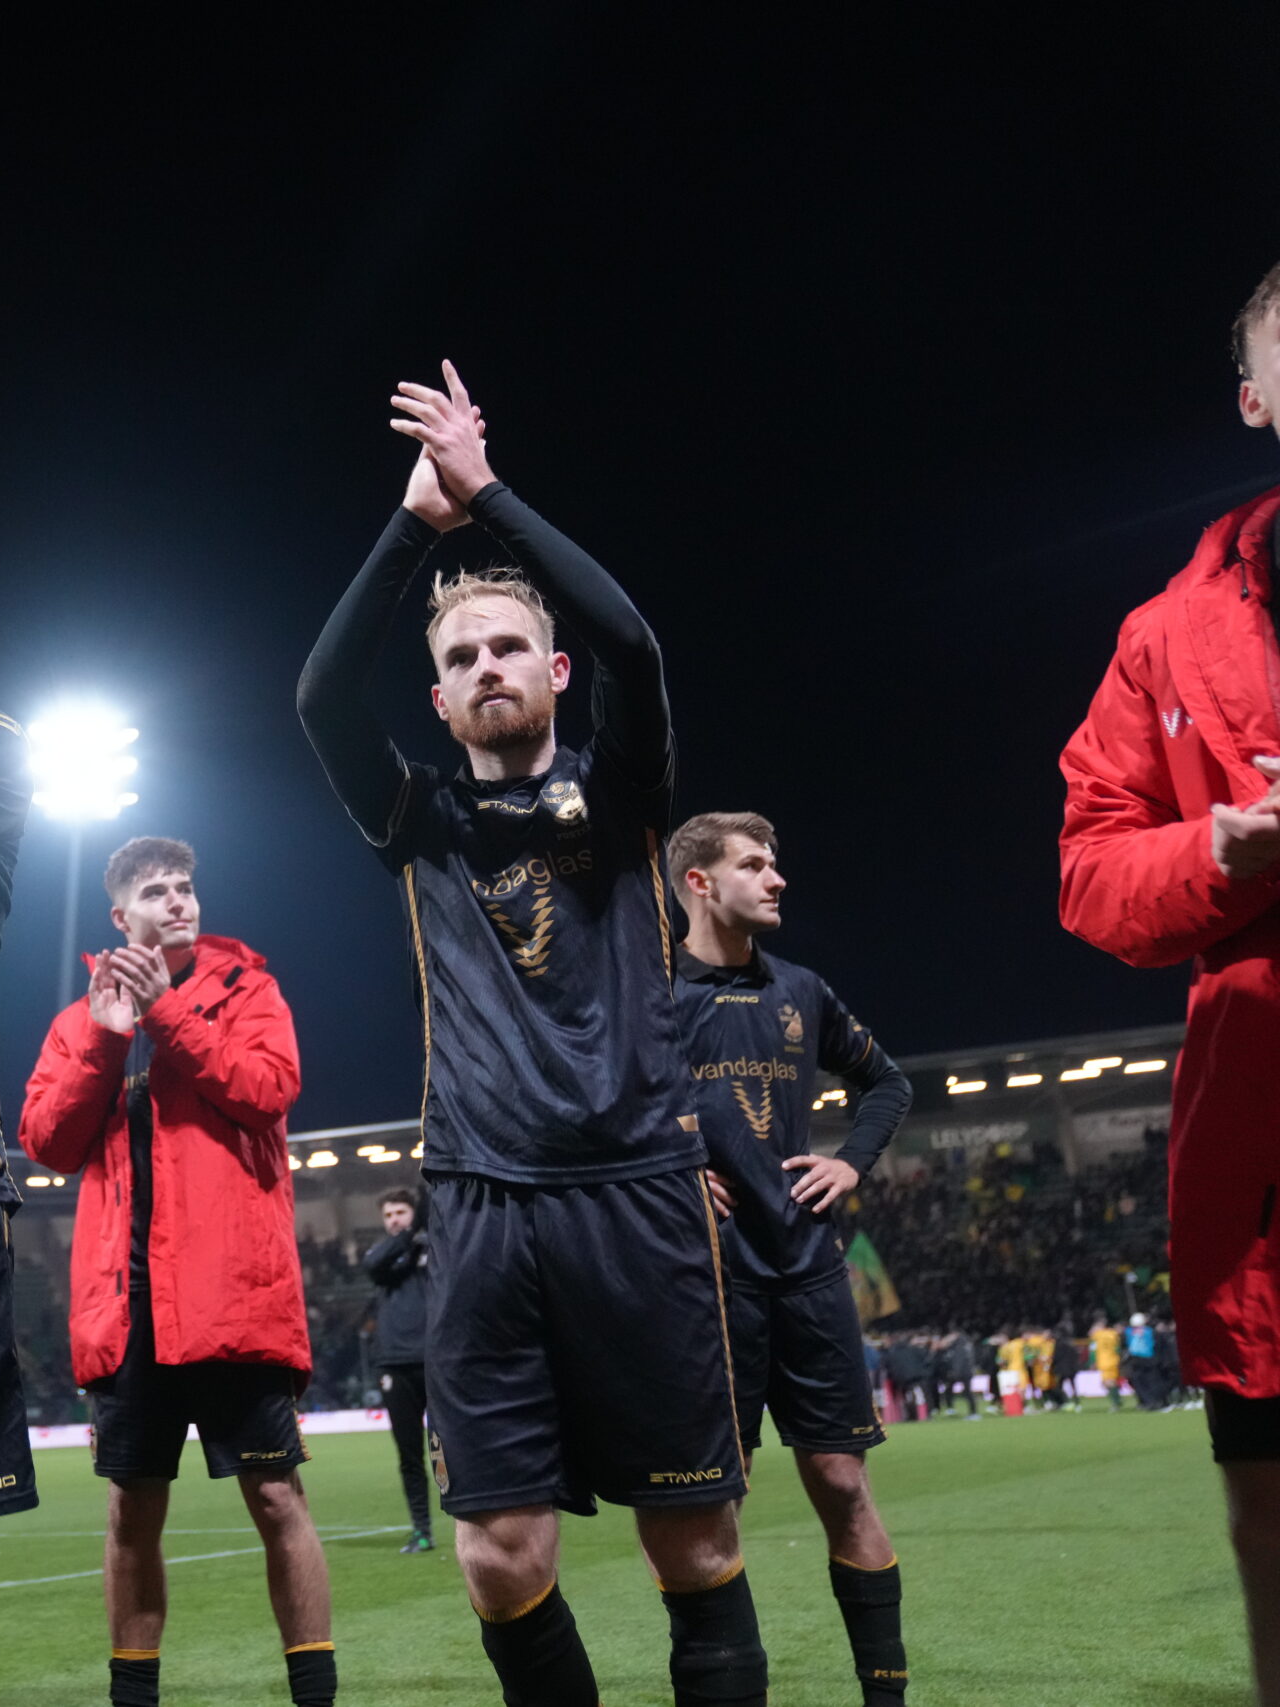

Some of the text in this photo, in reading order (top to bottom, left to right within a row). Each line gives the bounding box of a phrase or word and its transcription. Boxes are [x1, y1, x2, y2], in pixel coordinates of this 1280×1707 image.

[714, 995, 760, 1004] STANNO
[690, 1056, 798, 1083] vandaglas
[649, 1467, 722, 1485] STANNO
